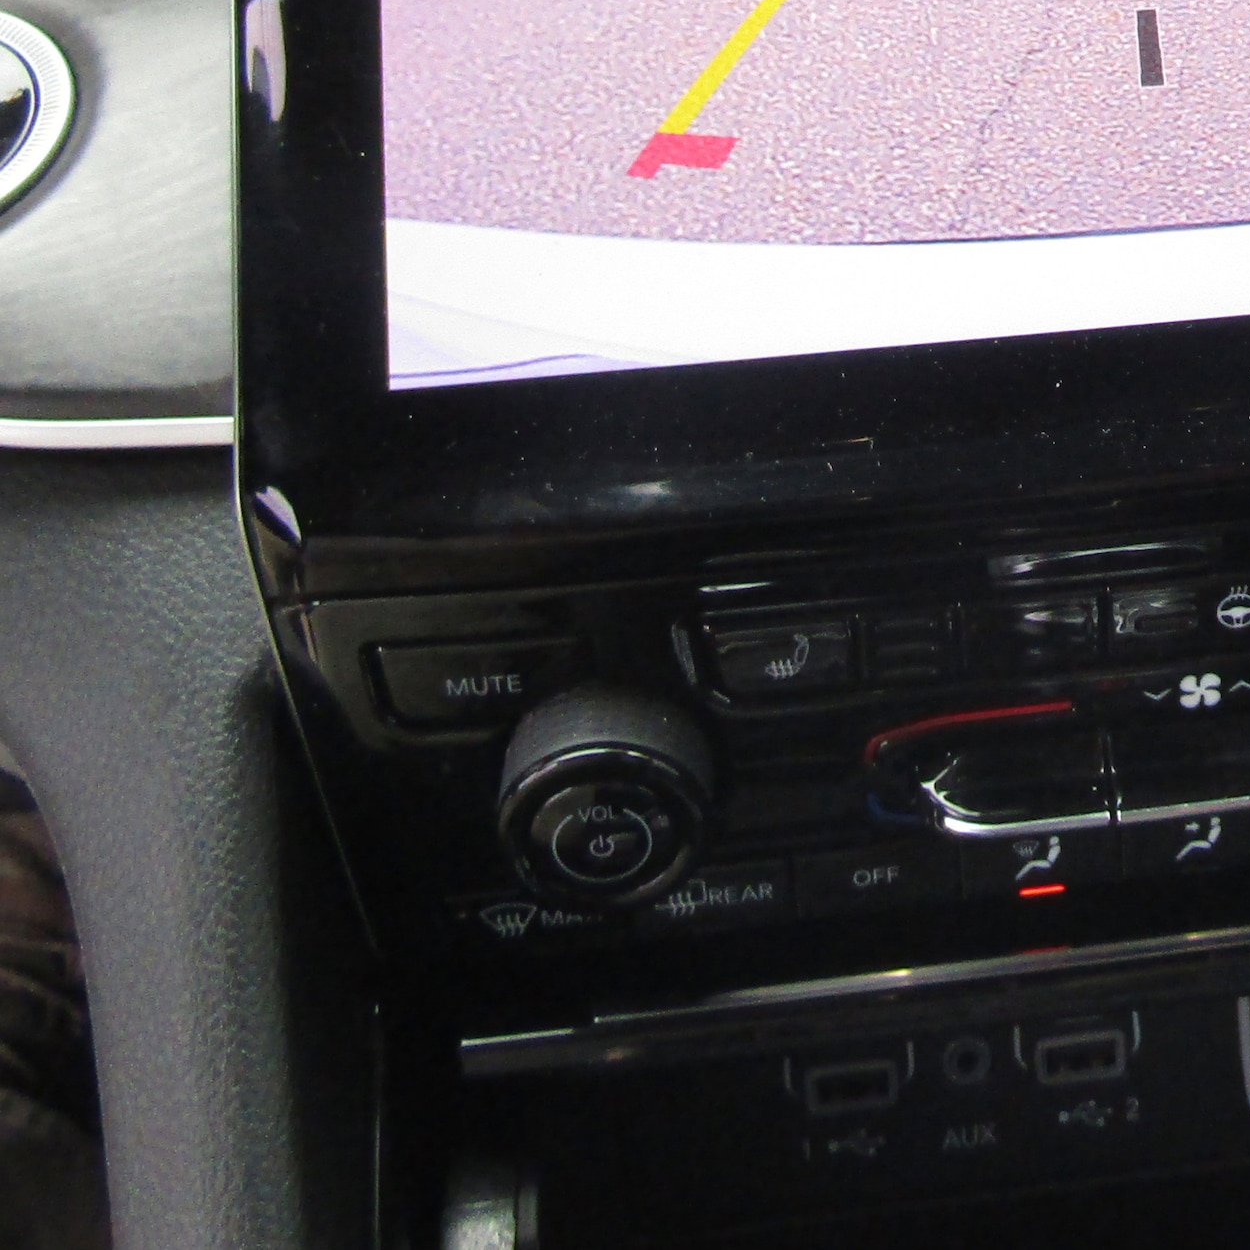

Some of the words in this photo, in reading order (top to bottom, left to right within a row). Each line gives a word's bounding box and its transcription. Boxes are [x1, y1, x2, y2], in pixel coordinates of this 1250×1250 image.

[445, 673, 523, 697] MUTE
[578, 804, 618, 824] VOL
[852, 865, 900, 888] OFF
[708, 881, 774, 905] REAR
[942, 1121, 998, 1153] AUX
